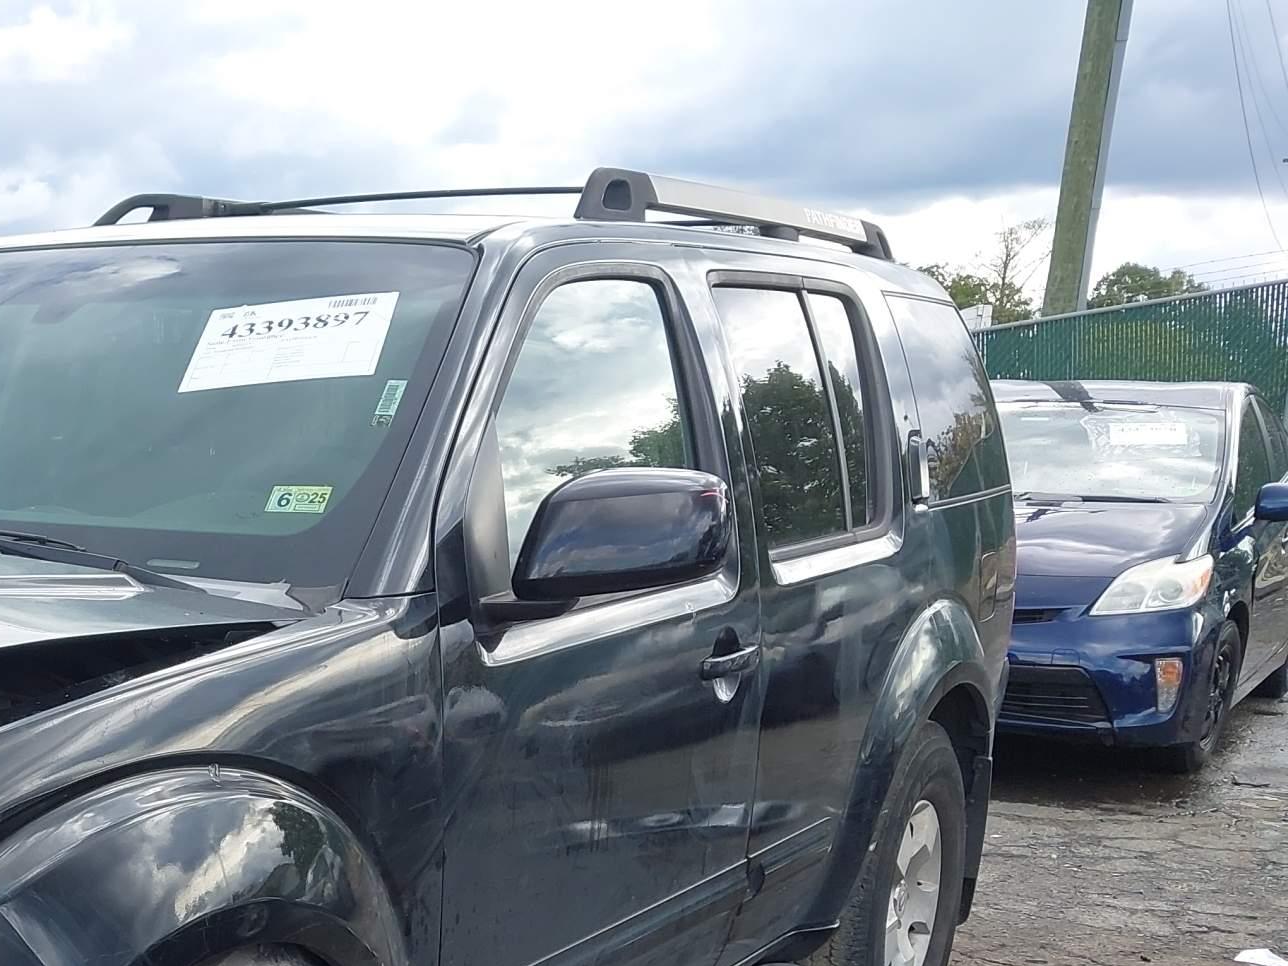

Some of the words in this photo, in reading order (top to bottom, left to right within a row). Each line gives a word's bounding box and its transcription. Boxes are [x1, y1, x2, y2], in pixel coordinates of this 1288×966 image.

[221, 311, 370, 338] 43393897
[277, 492, 292, 507] 6
[308, 492, 328, 504] 25
